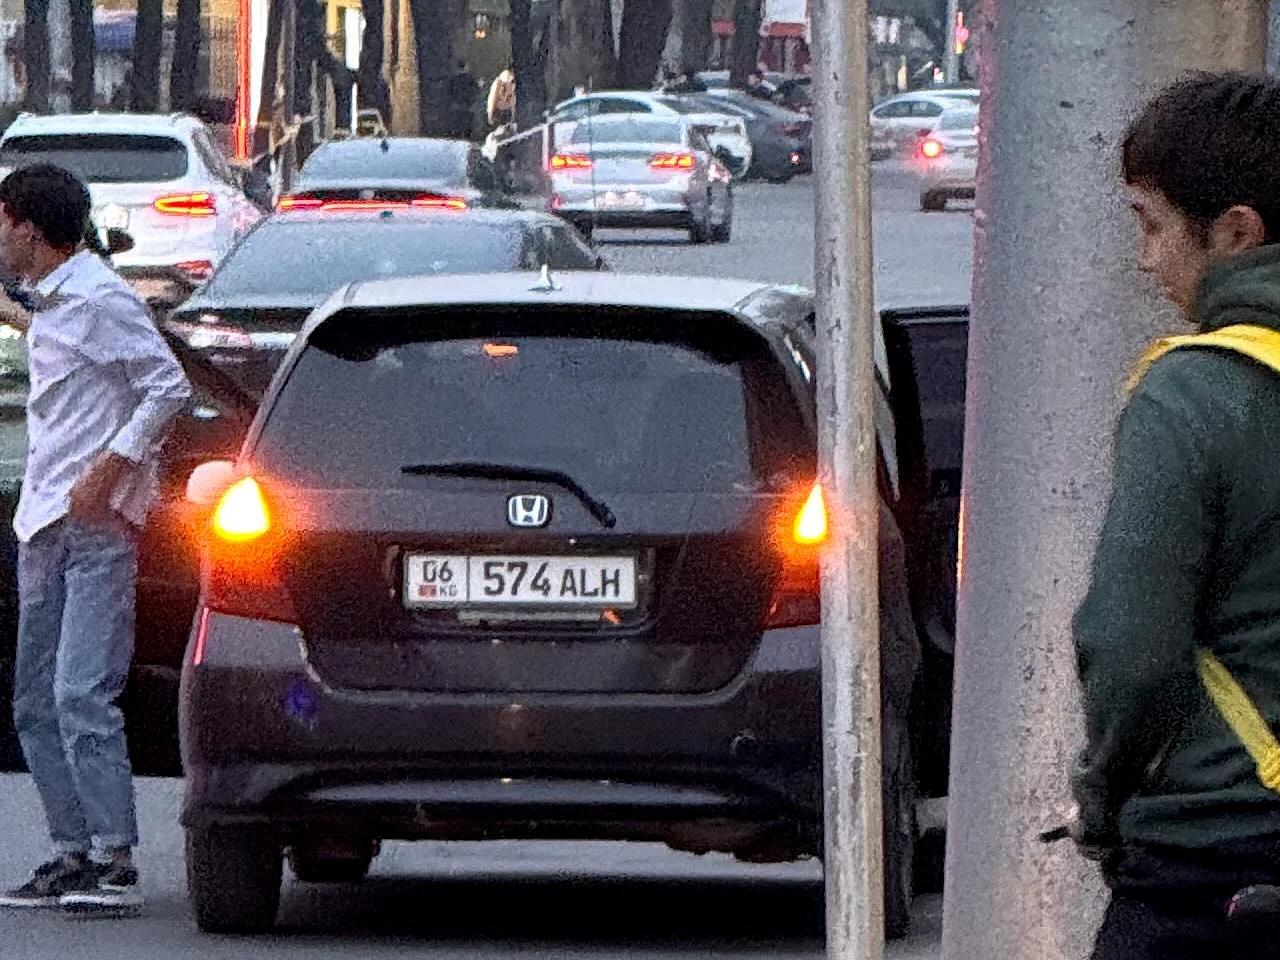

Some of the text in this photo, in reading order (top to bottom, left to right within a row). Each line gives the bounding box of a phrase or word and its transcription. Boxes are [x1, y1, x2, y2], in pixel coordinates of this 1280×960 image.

[422, 560, 621, 598] 06 574 ALH
